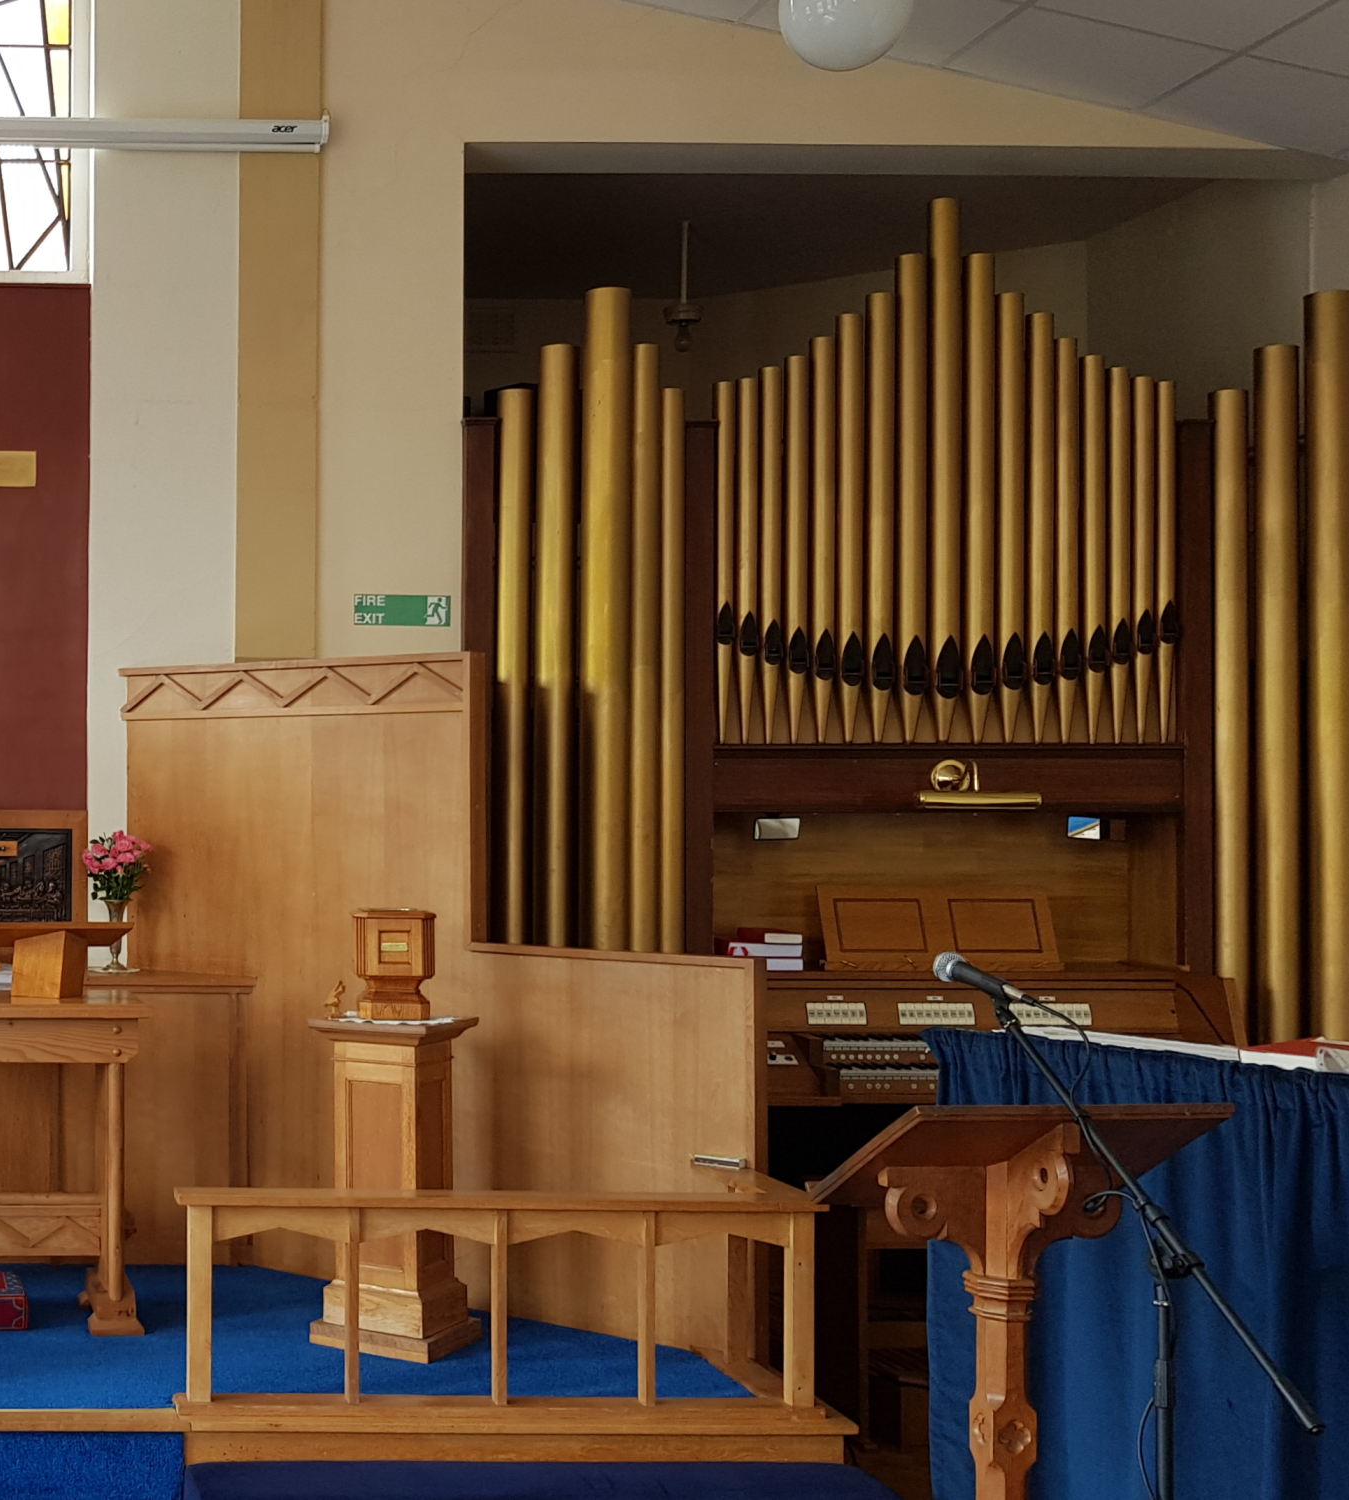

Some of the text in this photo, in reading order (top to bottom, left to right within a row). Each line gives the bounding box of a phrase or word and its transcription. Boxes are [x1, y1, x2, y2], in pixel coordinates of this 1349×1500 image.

[271, 125, 298, 133] acer
[354, 595, 386, 606] FIRE
[354, 613, 385, 624] EXIT
